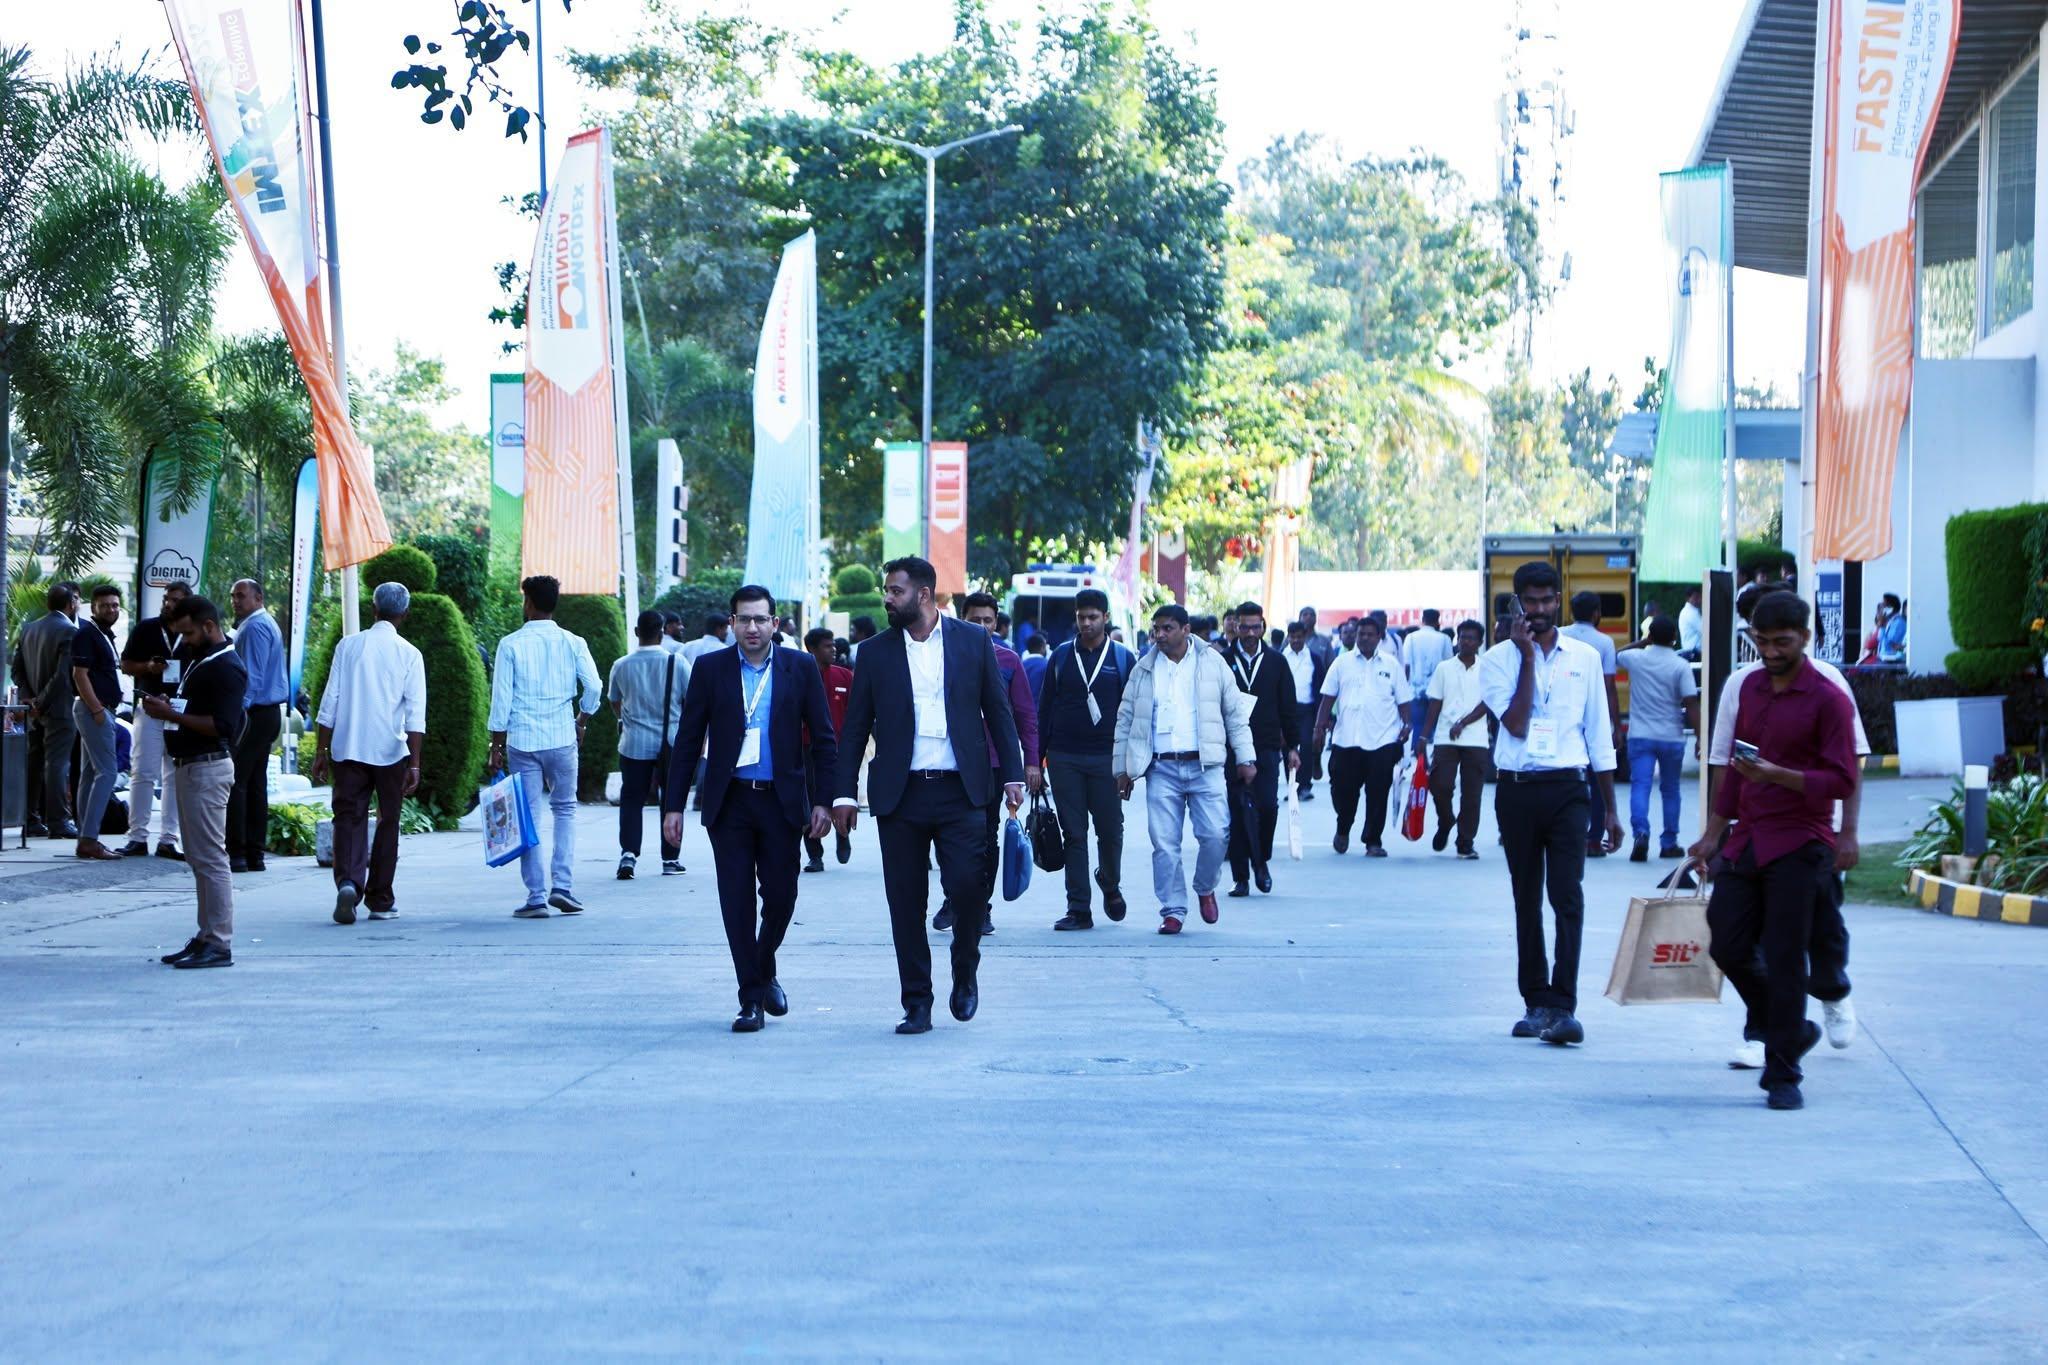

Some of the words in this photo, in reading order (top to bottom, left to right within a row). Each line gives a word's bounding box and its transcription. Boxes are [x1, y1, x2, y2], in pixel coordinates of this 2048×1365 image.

[1853, 0, 1906, 152] FASTN
[1888, 54, 1918, 157] International
[1908, 2, 1924, 47] trade
[151, 566, 191, 579] DIGITAL
